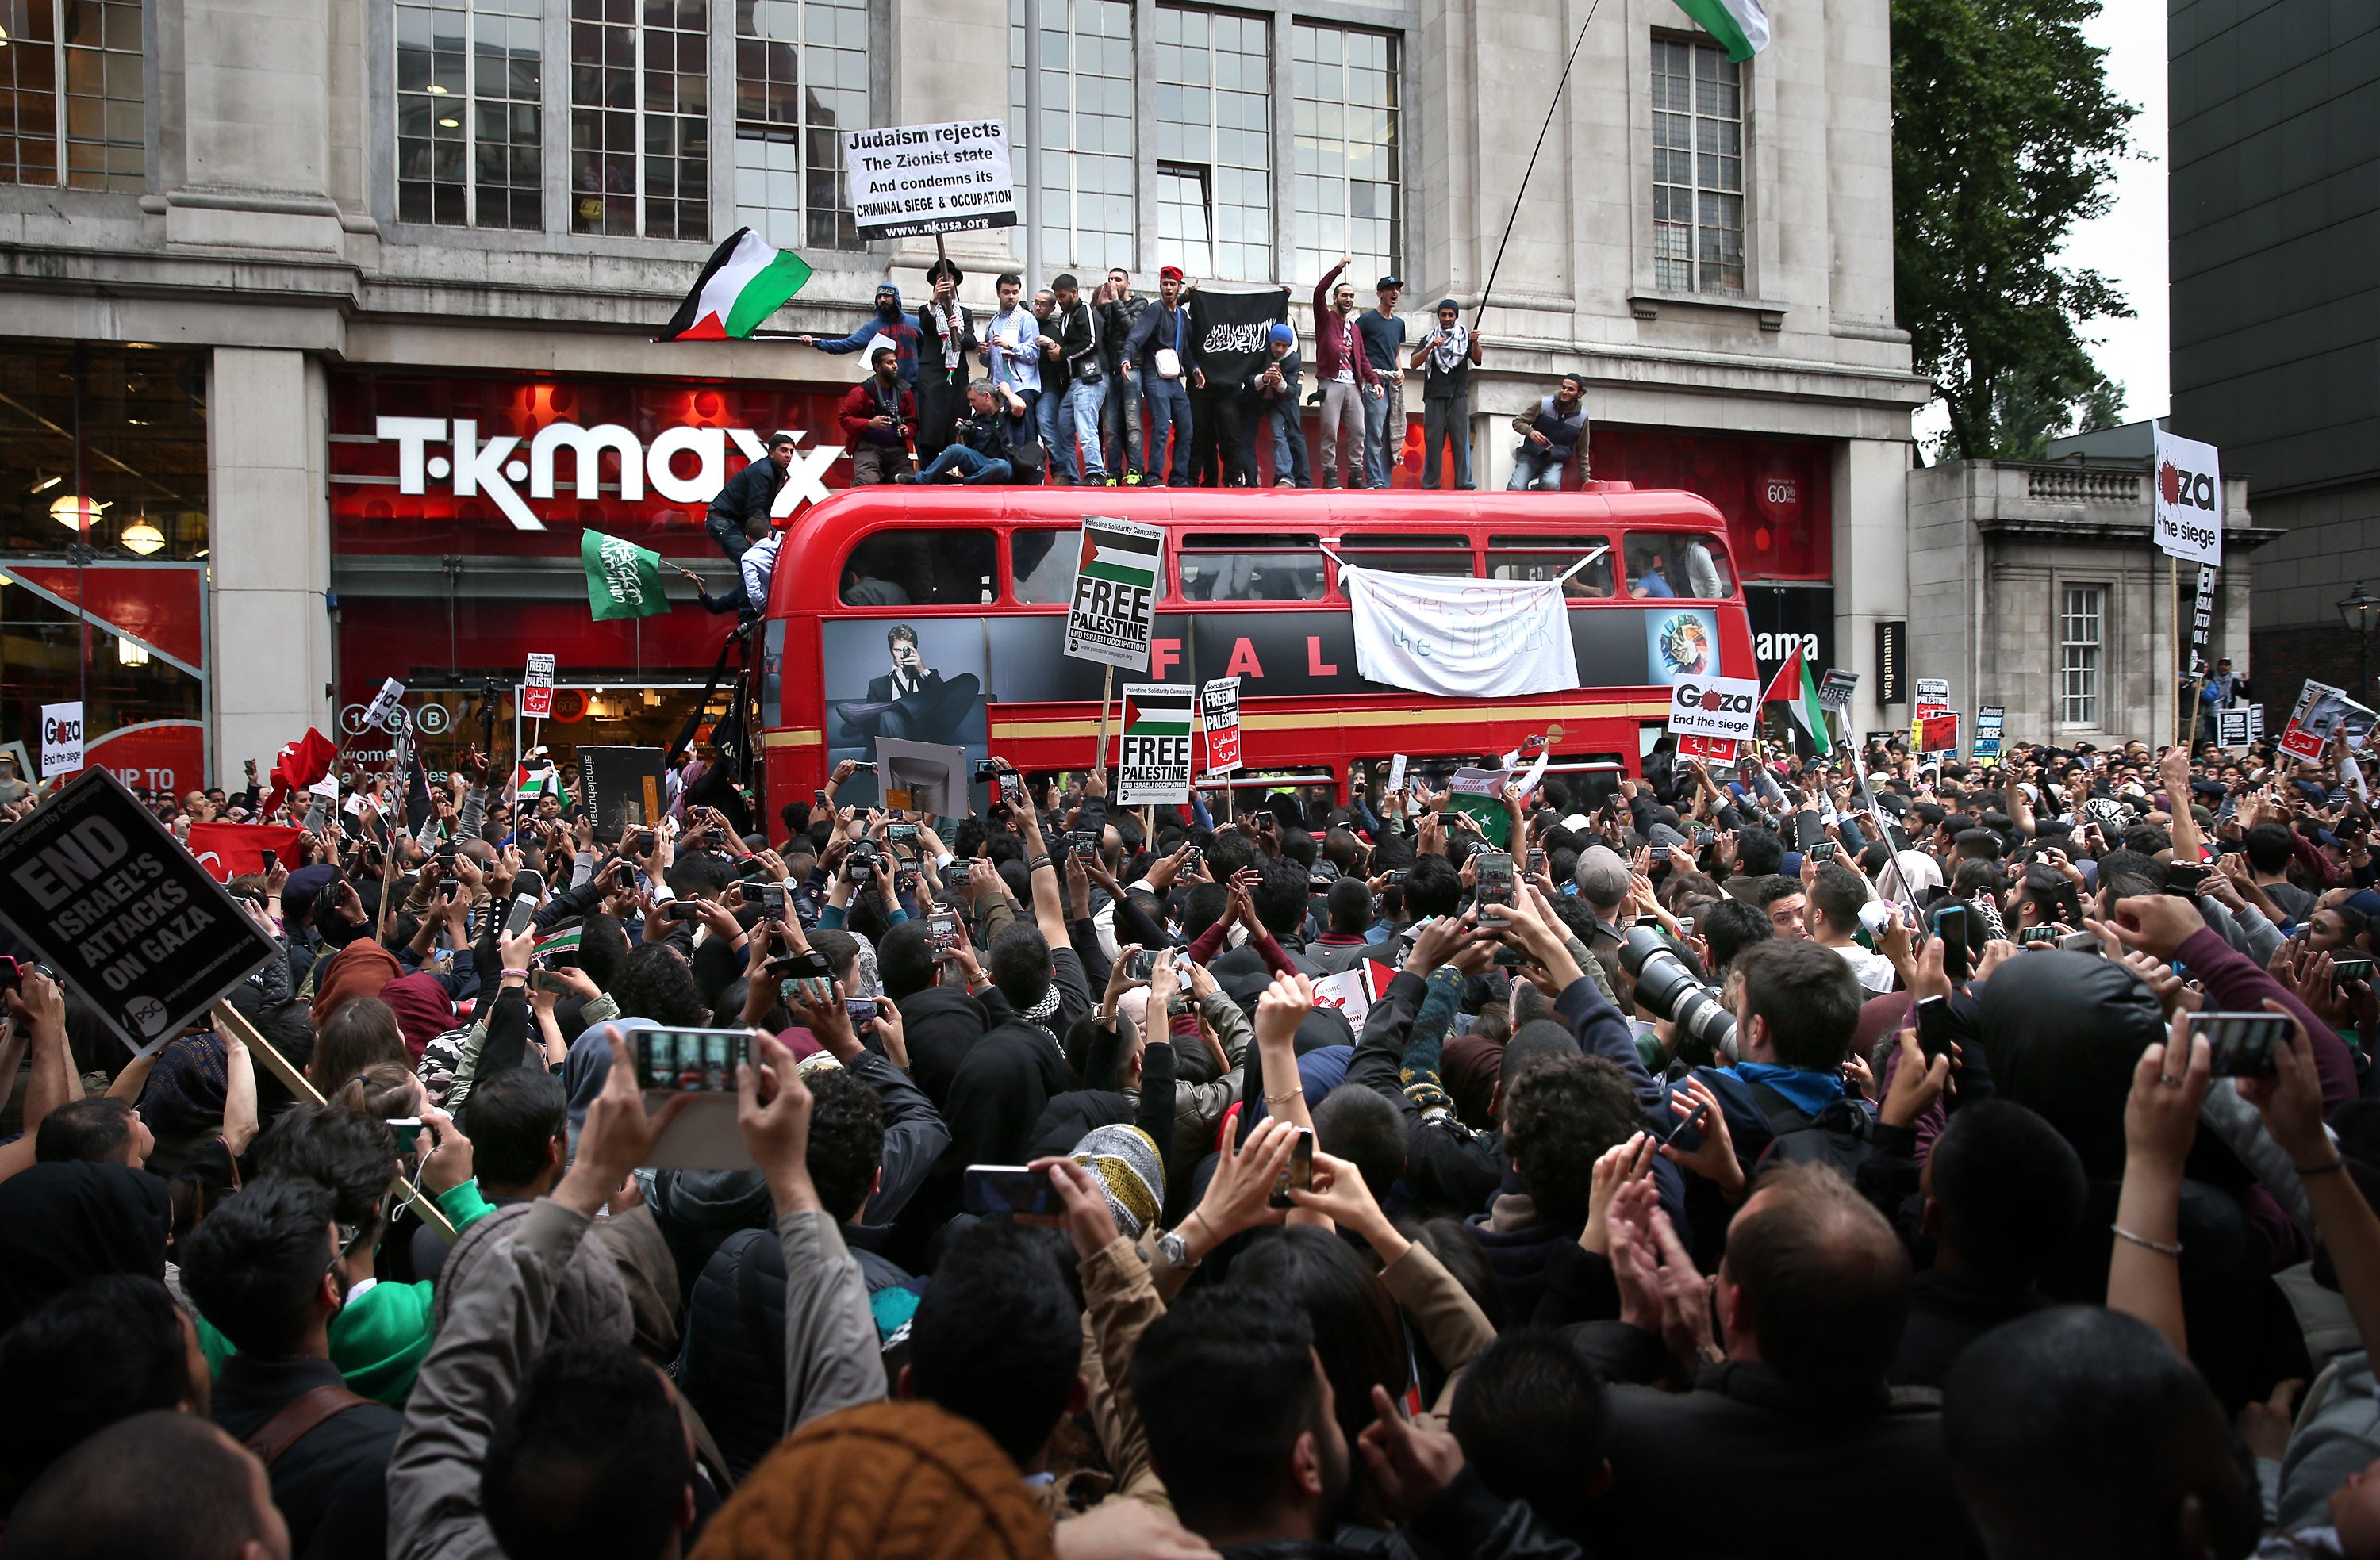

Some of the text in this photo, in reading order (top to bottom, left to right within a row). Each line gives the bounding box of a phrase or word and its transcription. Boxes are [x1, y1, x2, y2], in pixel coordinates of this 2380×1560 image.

[849, 121, 1001, 150] Judaism rejects
[862, 147, 993, 171] The Zionist state
[869, 170, 993, 194] And condemns its
[857, 190, 1012, 217] CRIMINAL SIEGE & OCCUPATION
[885, 218, 989, 236] www.nkusa.org
[1085, 519, 1161, 538] Palestine Solidarity Campaign
[2181, 522, 2215, 550] siege
[1073, 576, 1151, 624] FREE
[1461, 586, 1552, 616] STOP
[1070, 610, 1147, 642] PALESTINE
[1392, 609, 1554, 659] the MURDER
[1071, 630, 1145, 652] END ISRAELI OCCUPATION
[529, 661, 553, 673] FREEDO
[1883, 627, 1894, 700] wagamama
[1676, 684, 1752, 714] Gza
[1820, 687, 1852, 701] FREE
[44, 717, 81, 745] Gza
[351, 711, 441, 727] 1 G B
[1673, 714, 1694, 725] End
[1697, 716, 1715, 727] the
[1718, 719, 1749, 733] siege
[44, 750, 81, 766] End the siege
[1123, 736, 1189, 765] FREE
[145, 768, 175, 790] TO
[1121, 766, 1188, 780] PALESTINE
[57, 780, 104, 816] Campaign
[584, 754, 598, 826] simplehuman
[10, 814, 129, 911] END
[48, 853, 163, 943] ISRAEL'S
[78, 879, 189, 969] ATTACKS
[102, 906, 216, 991] ON GAZA
[1317, 984, 1342, 995] ISLAMIC
[135, 999, 163, 1025] PSC
